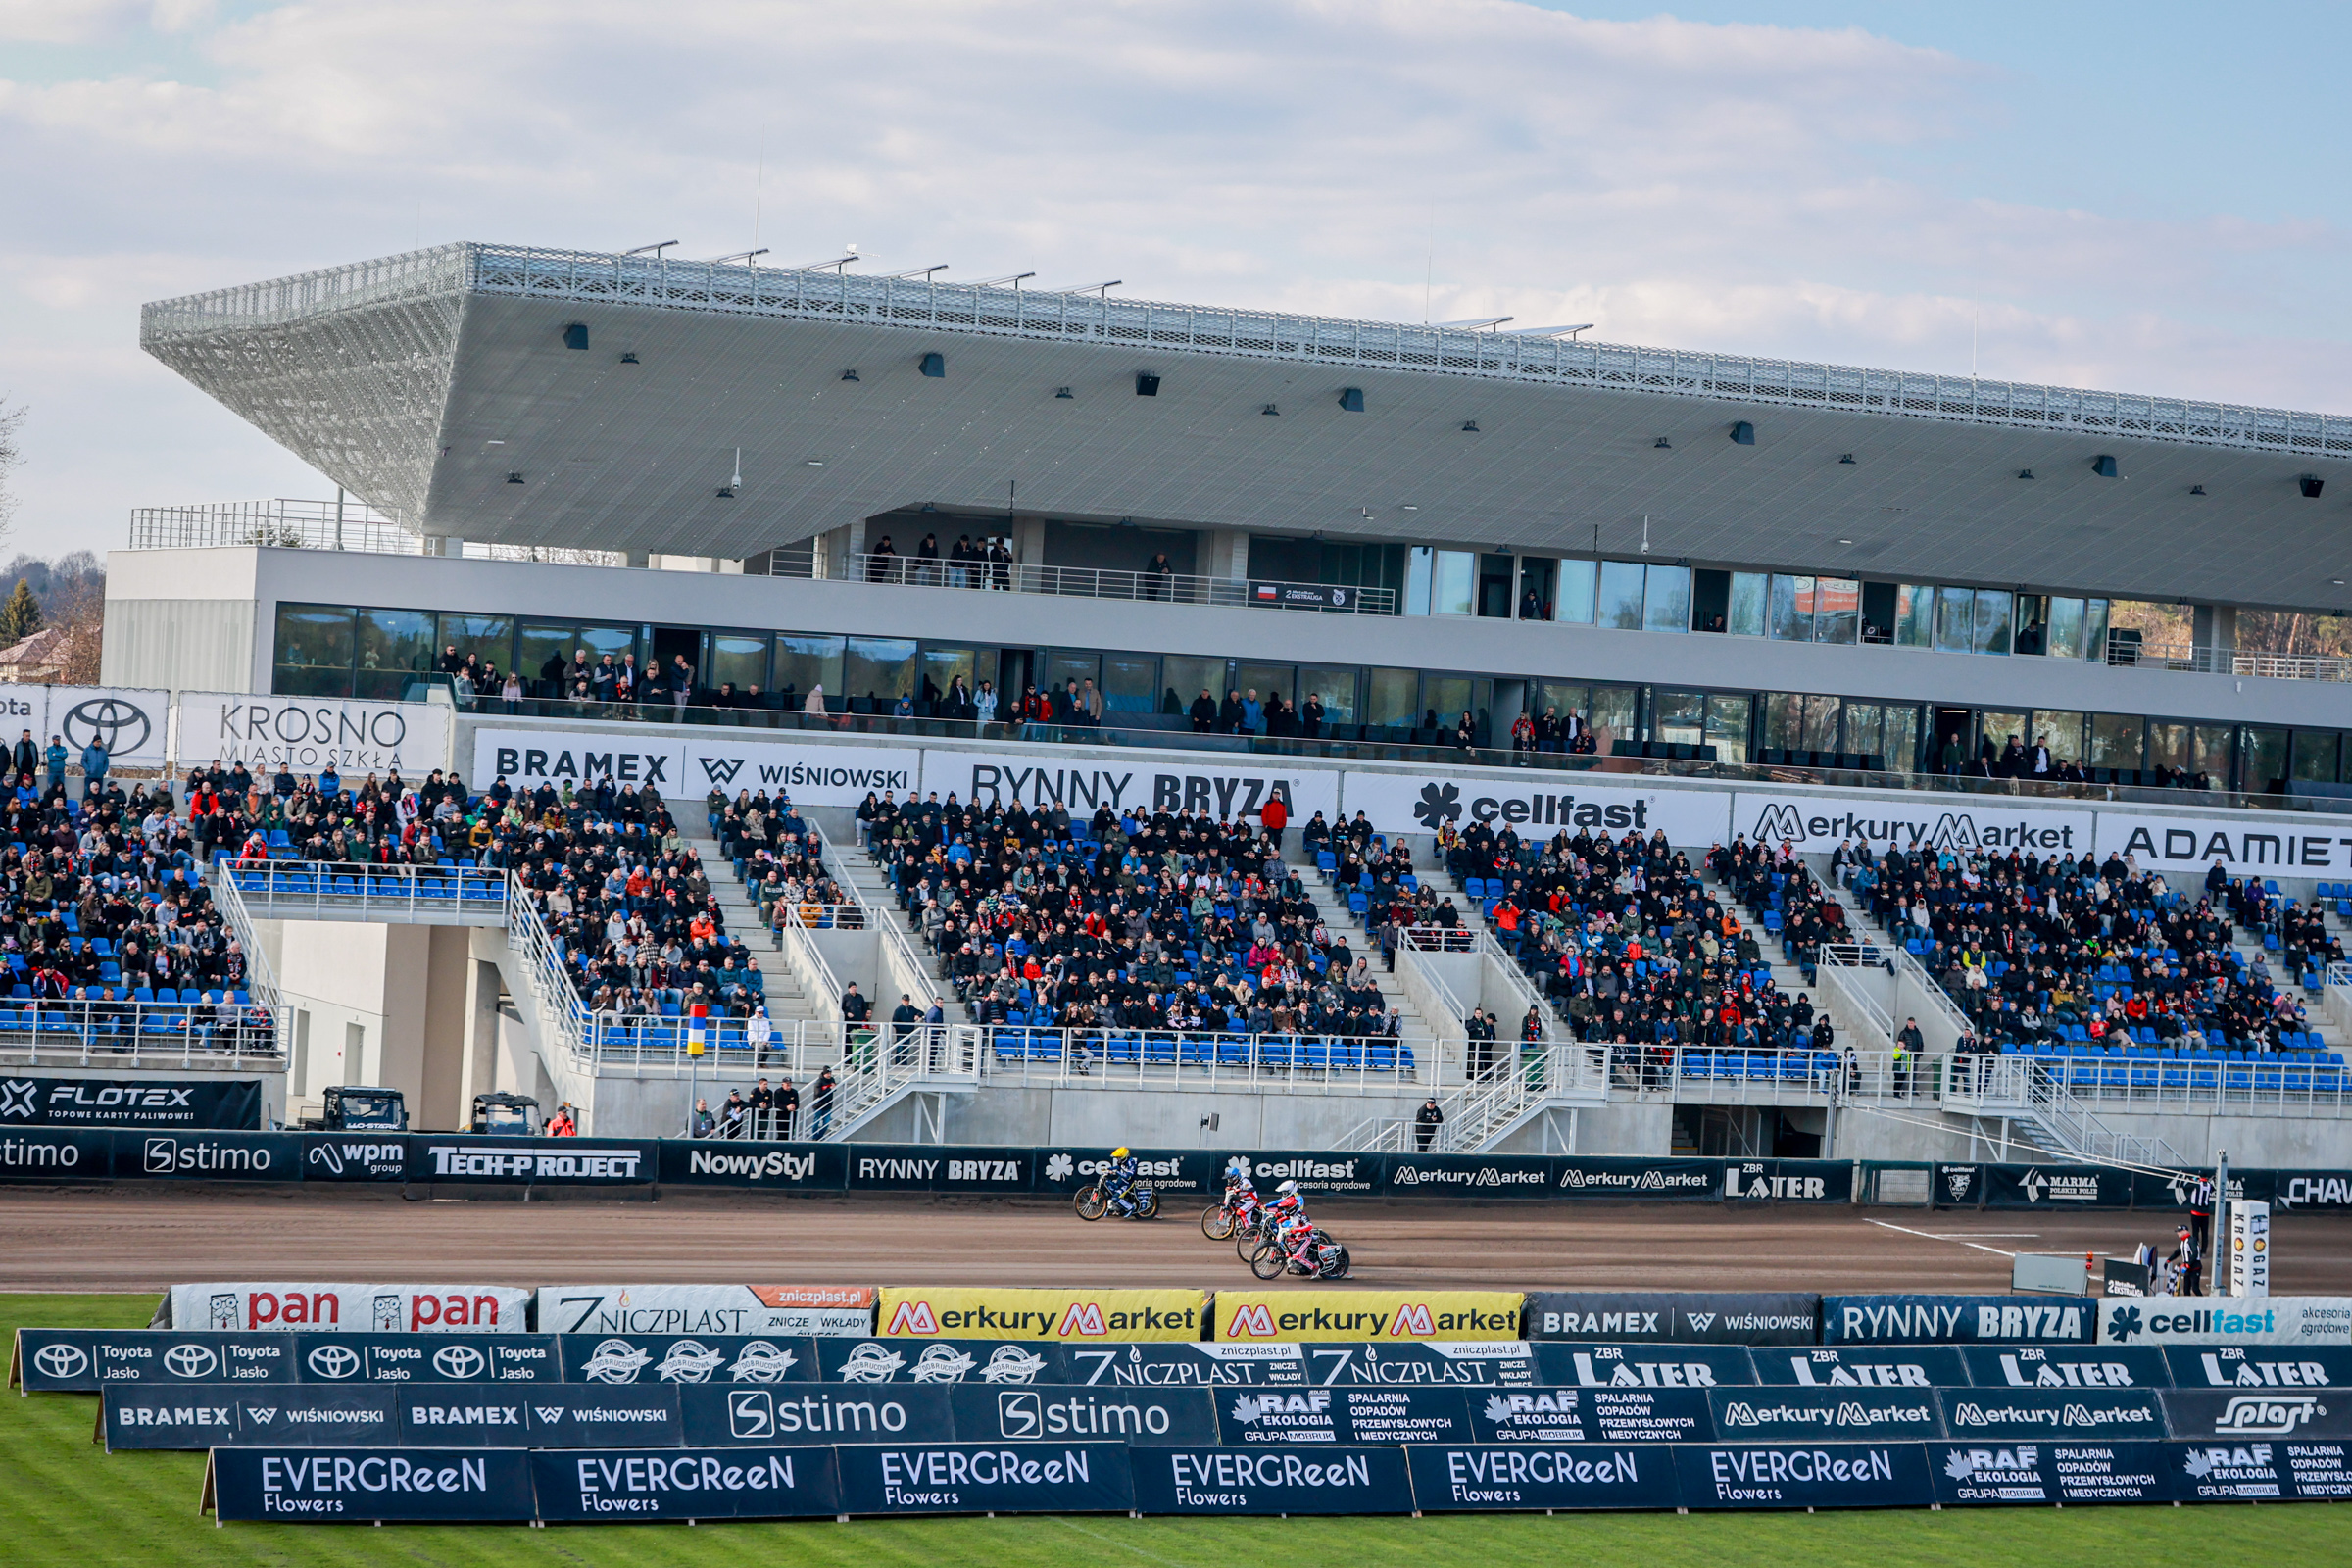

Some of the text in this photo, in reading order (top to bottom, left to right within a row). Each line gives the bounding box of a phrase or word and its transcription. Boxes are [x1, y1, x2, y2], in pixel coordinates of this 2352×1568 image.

[220, 704, 406, 748] KROSNO
[220, 744, 404, 770] MIASTO SZKŁA
[496, 747, 908, 789] BRAMEX WIŚNIOWSKI
[971, 764, 1295, 817] RYNNY BRYZA
[1471, 795, 1647, 829] cellfast
[1753, 804, 2073, 850] Merkury Market
[49, 1087, 194, 1106] FLOTEX
[134, 1111, 194, 1120] PALIWOWE!
[0, 1138, 79, 1166] timo
[178, 1142, 270, 1170] stimo
[342, 1144, 404, 1165] wpm
[370, 1163, 402, 1175] group
[428, 1147, 641, 1178] TECH-PROJECT
[690, 1151, 815, 1180] NowyStyl
[858, 1158, 1018, 1181] RYNNY BRYZA
[1255, 1159, 1355, 1179] cellfast
[1742, 1163, 1764, 1174] ZBR
[1394, 1166, 1545, 1186] Merkury Market
[1560, 1169, 1707, 1189] Merkury Market
[2049, 1176, 2098, 1188] MARMA
[1154, 1178, 1197, 1190] ogrodowe
[1330, 1180, 1371, 1191] ogrodowe
[1726, 1168, 1825, 1199] LATER
[779, 1290, 861, 1305] zniczplast.pl
[249, 1292, 339, 1330] pan
[411, 1294, 498, 1332] pan
[2302, 1306, 2351, 1320] akcesoria
[768, 1317, 867, 1328] ZNICZE WKŁADY
[887, 1301, 1195, 1336] Merkury Market
[1227, 1303, 1516, 1337] Merkury Market
[1544, 1312, 1813, 1333] BRAMEX WIŚNIOWSKI
[1843, 1305, 2082, 1339] RYNNY BRYZA
[2149, 1309, 2276, 1334] cellfast
[2301, 1323, 2350, 1337] ogrodowe
[102, 1345, 153, 1361] Toyota
[229, 1345, 281, 1360] Toyota
[372, 1347, 422, 1362] Toyota
[496, 1346, 547, 1361] Toyota
[1221, 1347, 1292, 1357] zniczplast.pl
[1453, 1345, 1521, 1355] zniczplast.pl
[1593, 1348, 1624, 1359] ZBR
[1811, 1351, 1840, 1362] ZBR
[2020, 1349, 2046, 1361] ZBR
[2220, 1348, 2246, 1360] ZBR
[595, 1358, 636, 1369] DOBRUCOWA
[668, 1359, 710, 1369] DOBRUCOWA
[741, 1360, 782, 1370] DOBRUCOWA
[851, 1362, 891, 1371] DOBRUCOWA
[922, 1363, 962, 1373] DOBRUCOWA
[993, 1363, 1032, 1373] DOBRUCOWA
[1499, 1360, 1526, 1369] ZNICZE
[1573, 1353, 1716, 1387] LATER
[2201, 1353, 2330, 1388] LATER
[103, 1366, 140, 1379] Jasło
[231, 1366, 269, 1379] Jasło
[374, 1367, 411, 1380] Jasło
[499, 1367, 535, 1380] Jasło
[1269, 1372, 1301, 1382] WKŁADY
[1498, 1371, 1531, 1380] WKŁADY
[1790, 1357, 1931, 1387] LATER
[1999, 1354, 2134, 1388] LATER
[1259, 1395, 1331, 1413] RAF
[1348, 1394, 1410, 1403] SPALARNIA
[1509, 1395, 1578, 1413] RAF
[1595, 1394, 1654, 1403] SPALARNIA
[119, 1407, 384, 1426] BRAMEX WIŚNIOWSKI
[412, 1406, 667, 1424] BRAMEX WIŚNIOWSKI
[778, 1394, 906, 1432] stimo
[1046, 1396, 1170, 1435] stimo
[1350, 1405, 1406, 1416] ODPADÓW
[1597, 1404, 1650, 1416] ODPADÓW
[1725, 1401, 1930, 1426] Merkury Market
[1955, 1402, 2153, 1426] Merkury Market
[2215, 1396, 2317, 1434] Splast
[1263, 1415, 1334, 1426] EKOLOGIA
[1352, 1418, 1452, 1429] PRZEMYSŁOWYCH
[1514, 1414, 1582, 1425] EKOLOGIA
[1599, 1417, 1694, 1428] PRZEMYSŁOWYCH
[1245, 1431, 1334, 1442] GRUPA MOBRUK
[1354, 1431, 1437, 1441] I MEDYCZNYCH
[1496, 1430, 1584, 1440] GRUPA MOBRUK
[1602, 1430, 1681, 1440] I MEDYCZNYCH
[2055, 1448, 2114, 1459] SPALARNIA
[2207, 1448, 2272, 1467] RAF
[2287, 1446, 2344, 1456] SPALARNIA
[1970, 1450, 2037, 1469] RAF
[2057, 1460, 2111, 1473] ODPADÓW
[2290, 1455, 2342, 1469] ODPADÓW
[1975, 1471, 2042, 1483] EKOLOGIA
[2060, 1474, 2156, 1486] PRZEMYSŁOWYCH
[2213, 1468, 2278, 1480] EKOLOGIA
[885, 1487, 959, 1505] Flowers
[1176, 1488, 1247, 1505] Flowers
[1452, 1485, 1520, 1502] Flowers
[1715, 1483, 1782, 1500] Flowers
[1957, 1488, 2043, 1498] GRUPA MOBRUK
[2063, 1488, 2142, 1497] I MEDYCZNYCH
[2197, 1485, 2278, 1496] GRUPA MOBRUK
[2296, 1484, 2301, 1495] I
[264, 1494, 343, 1512] Flowers
[581, 1493, 659, 1511] Flowers
